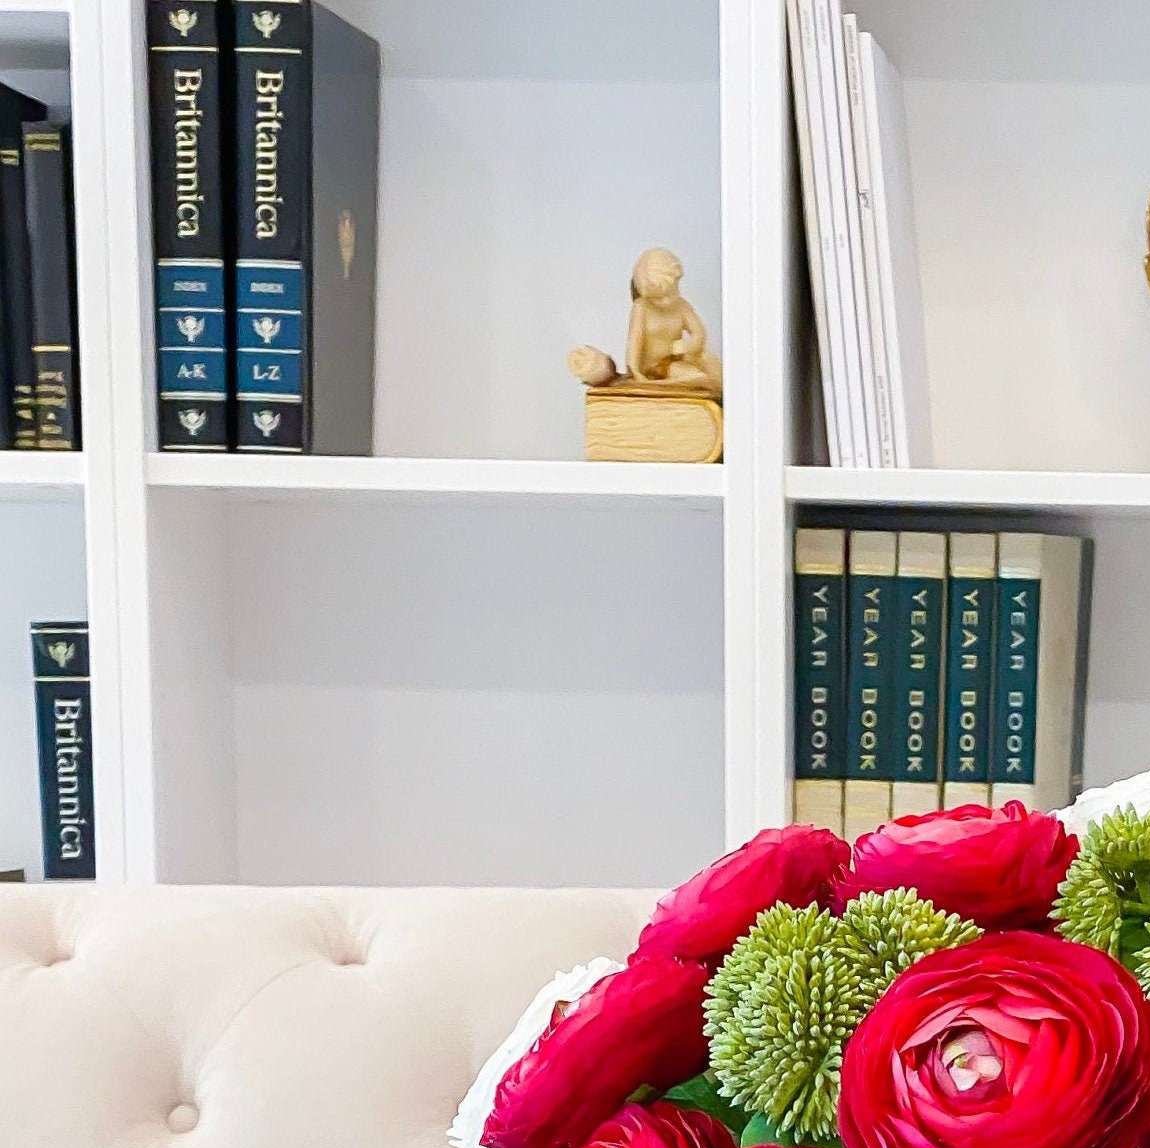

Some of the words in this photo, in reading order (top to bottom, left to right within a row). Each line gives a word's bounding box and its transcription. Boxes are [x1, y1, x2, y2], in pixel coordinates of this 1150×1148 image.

[174, 69, 204, 239] Britannica
[256, 70, 285, 240] Britannica
[253, 364, 282, 381] L-Z
[811, 586, 828, 666] YEAR
[862, 588, 880, 666] YEAR
[910, 590, 928, 669] YEAR
[961, 589, 978, 669] YEAR
[1010, 590, 1026, 670] YEAR
[811, 687, 828, 769] BOOK
[860, 688, 878, 770] BOOK
[907, 690, 925, 772] BOOK
[959, 690, 977, 772] BOOK
[1006, 691, 1024, 772] BOOK
[54, 699, 87, 859] Britannica
